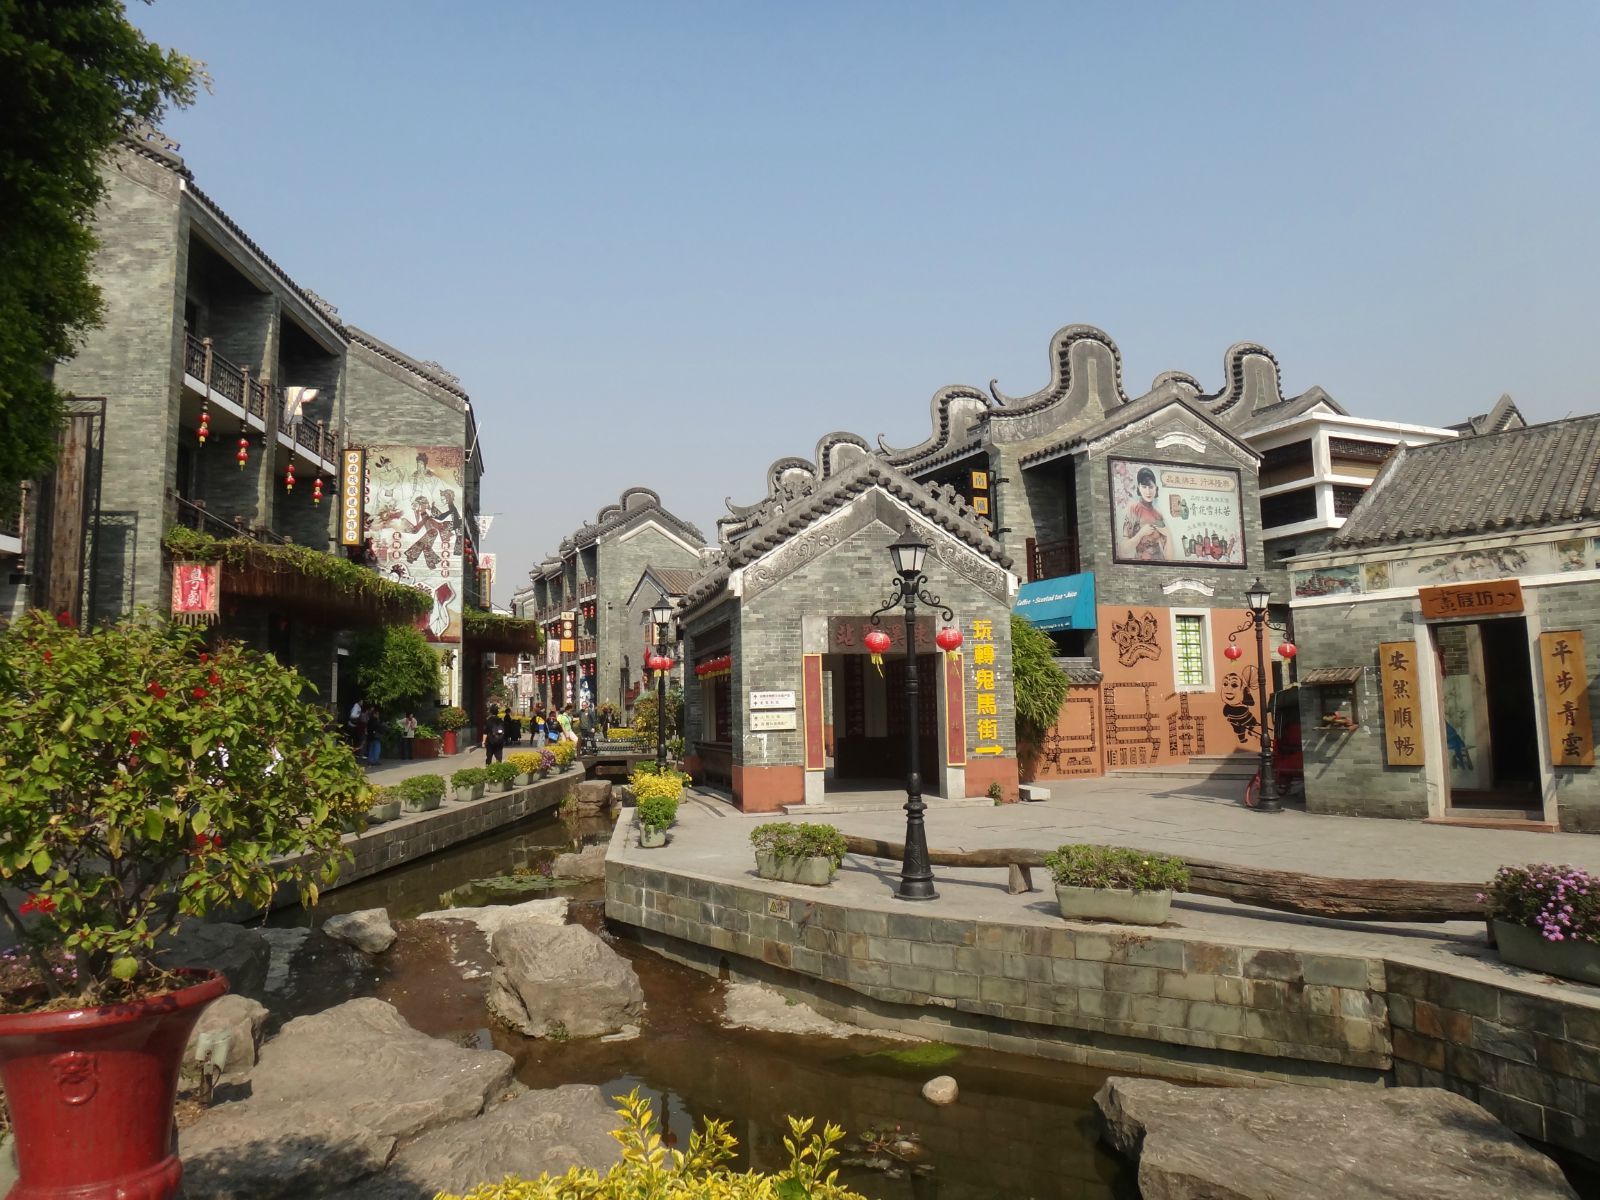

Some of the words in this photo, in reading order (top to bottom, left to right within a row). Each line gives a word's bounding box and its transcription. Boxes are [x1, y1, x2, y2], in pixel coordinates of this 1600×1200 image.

[1017, 598, 1032, 607] Coffee
[973, 619, 998, 740] 玩轉鬼馬街
[1551, 639, 1584, 758] 平步青雲
